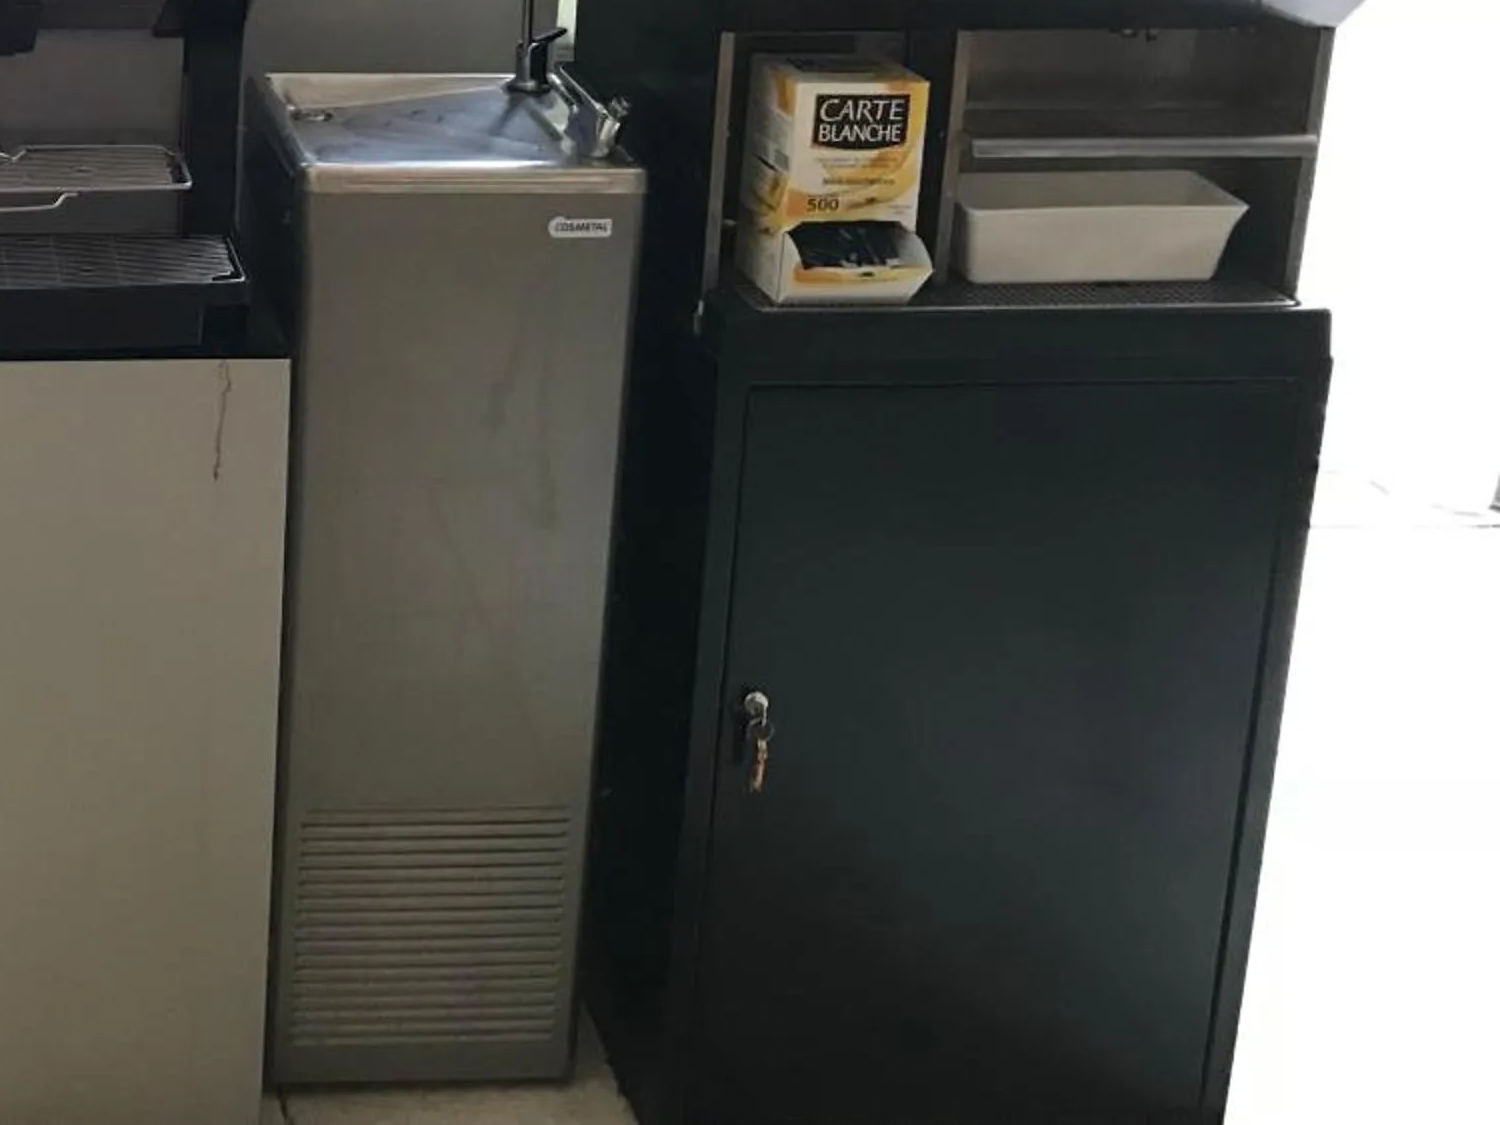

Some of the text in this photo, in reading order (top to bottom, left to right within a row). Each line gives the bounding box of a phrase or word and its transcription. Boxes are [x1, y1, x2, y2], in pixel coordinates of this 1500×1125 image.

[819, 98, 905, 122] CARTE
[818, 124, 902, 142] BLANCHE
[807, 198, 839, 213] 500
